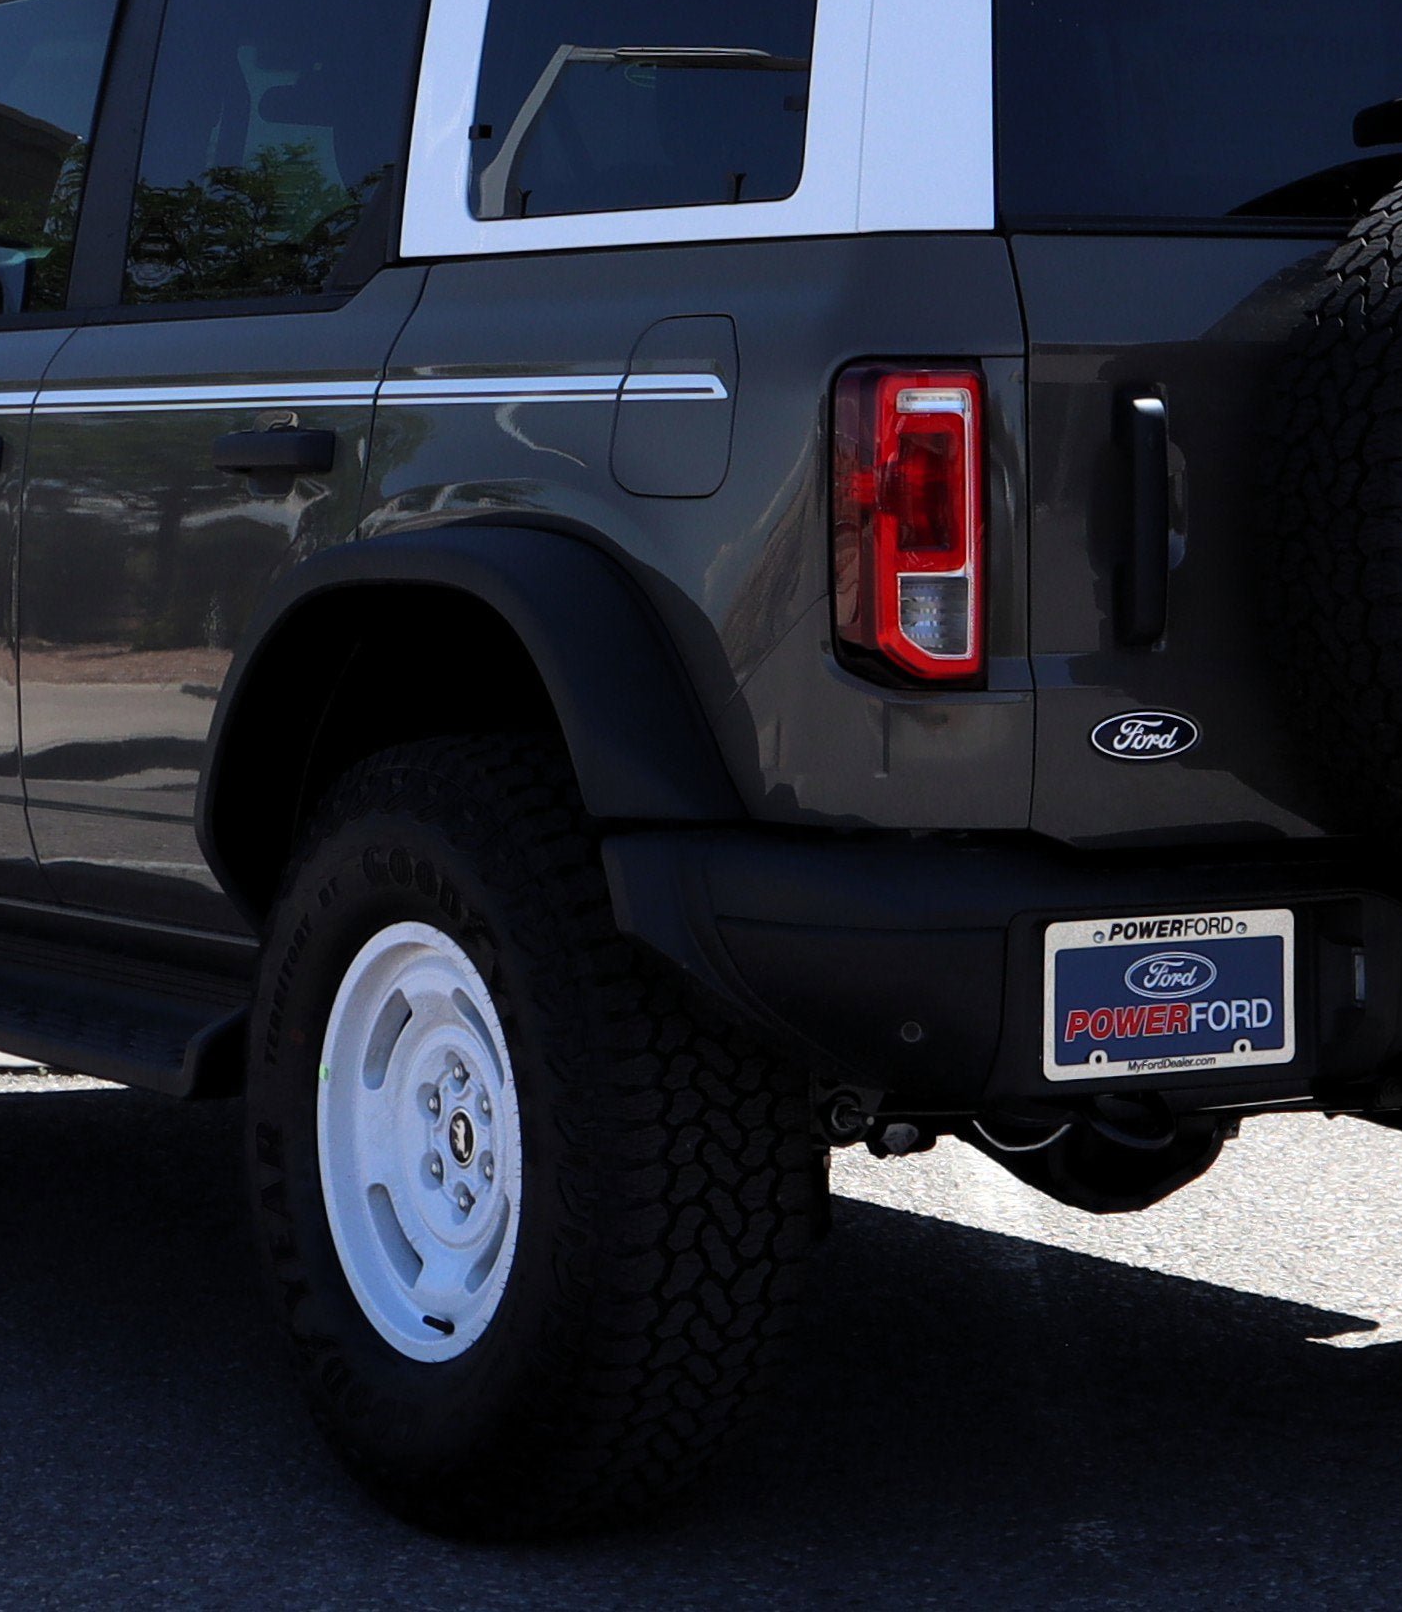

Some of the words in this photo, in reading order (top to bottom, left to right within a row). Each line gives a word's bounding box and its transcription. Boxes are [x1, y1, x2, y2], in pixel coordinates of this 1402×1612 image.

[1112, 719, 1178, 751] Ford
[1143, 960, 1199, 989] Ford
[1127, 1056, 1217, 1074] MyFordDealer.com
